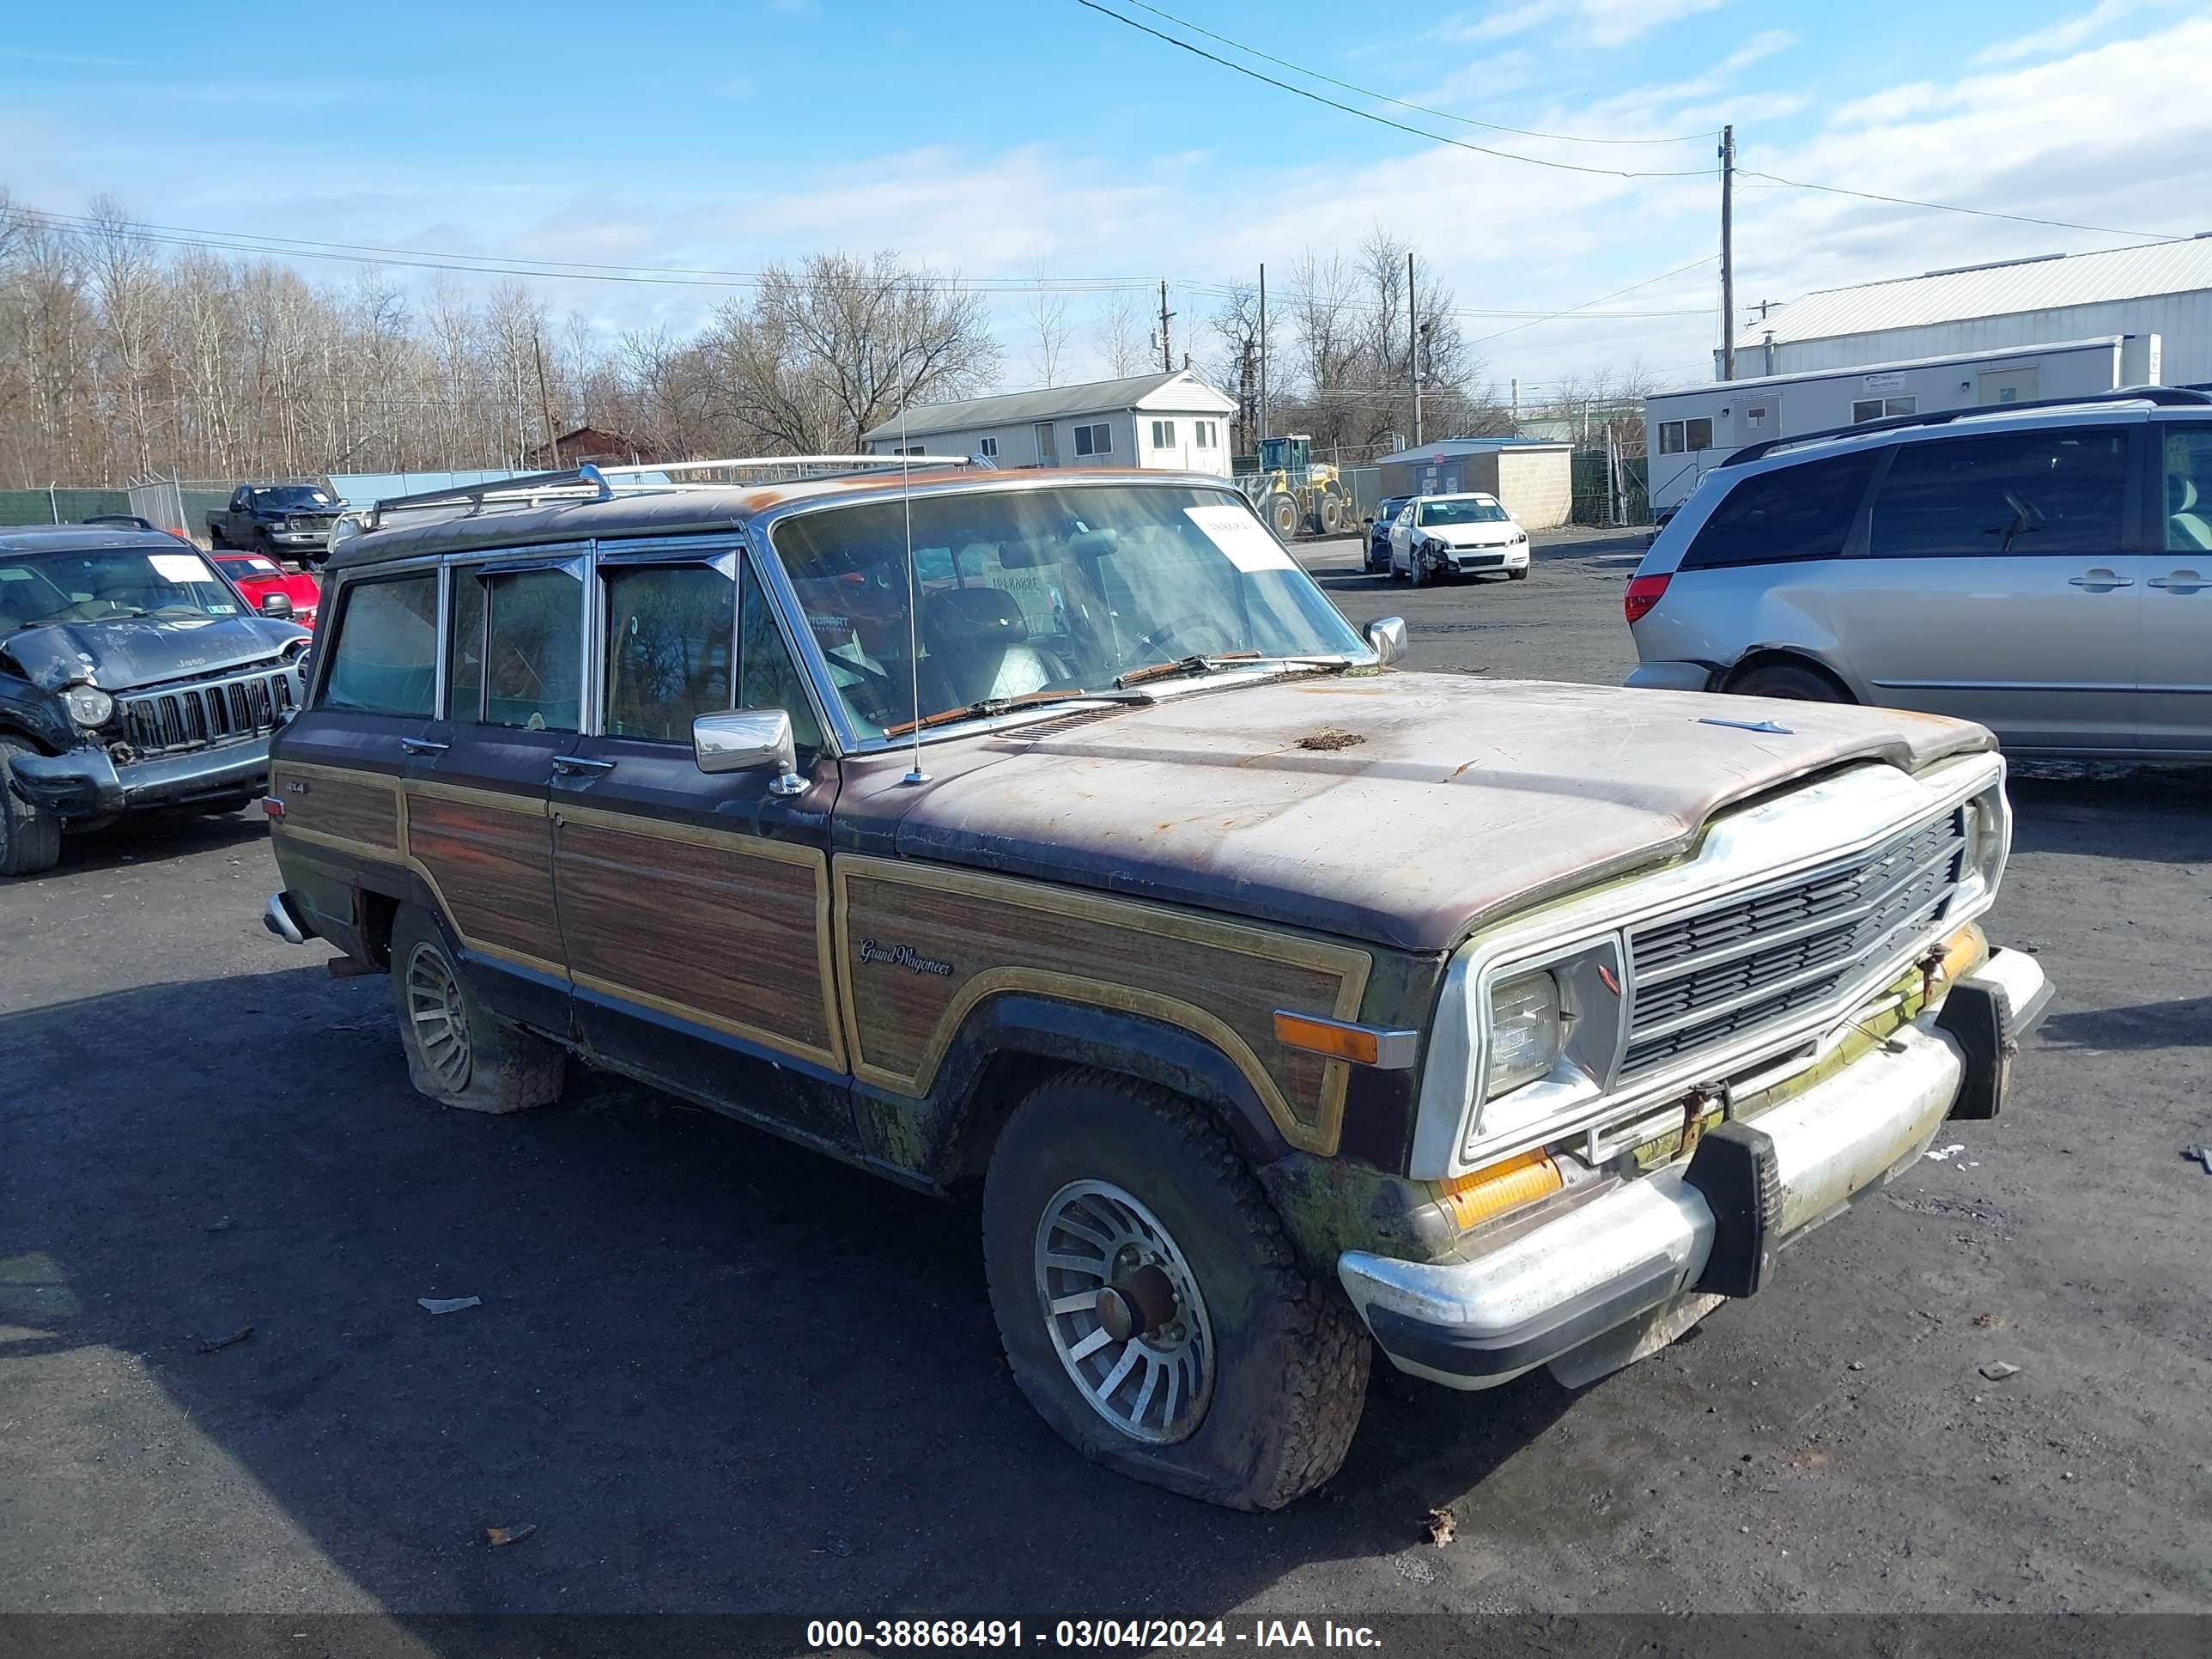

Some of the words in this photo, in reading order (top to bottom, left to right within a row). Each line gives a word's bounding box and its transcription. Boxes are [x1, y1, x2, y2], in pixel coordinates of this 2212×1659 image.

[809, 616, 849, 626] TOPART
[177, 657, 207, 668] Jeep
[860, 939, 896, 963] Grand
[896, 945, 951, 975] Wagoneer
